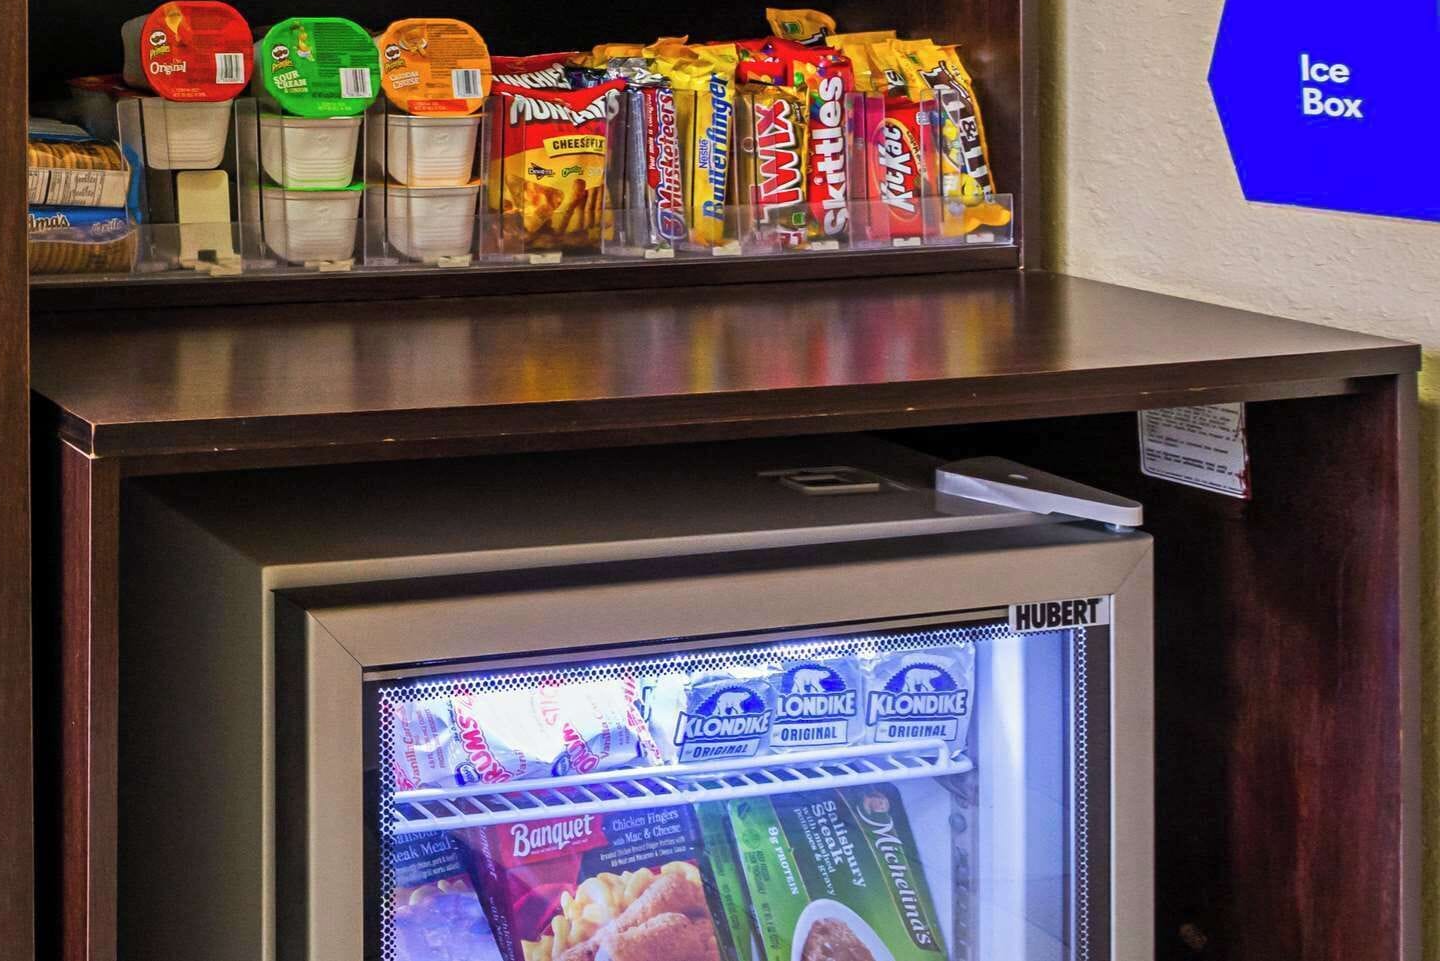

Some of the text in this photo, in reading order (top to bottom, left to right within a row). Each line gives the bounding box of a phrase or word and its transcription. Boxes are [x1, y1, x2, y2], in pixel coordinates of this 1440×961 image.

[1300, 53, 1350, 83] Ice
[1302, 87, 1364, 119] Box
[657, 88, 684, 213] Musketeers
[702, 72, 734, 221] Butterfinger
[751, 98, 802, 224] TWIX
[812, 76, 849, 236] Skittles
[1015, 597, 1104, 631] HUBERT
[776, 689, 857, 718] LONDIKE
[867, 689, 969, 726] KLONDIKE
[675, 709, 773, 746] KLONDIKE
[780, 726, 838, 742] ORIGINAL
[888, 724, 947, 738] ORIGINAL
[693, 743, 750, 758] ORIGINAL
[510, 813, 596, 857] Banquet
[611, 809, 679, 832] Chicken Fingers
[625, 831, 643, 843] Mac
[643, 827, 651, 839] &
[811, 804, 843, 865] Steak
[823, 799, 866, 888] Salisbury
[776, 846, 799, 896] PROTEIN
[817, 864, 837, 896] gravy
[856, 803, 931, 945] Michelina's
